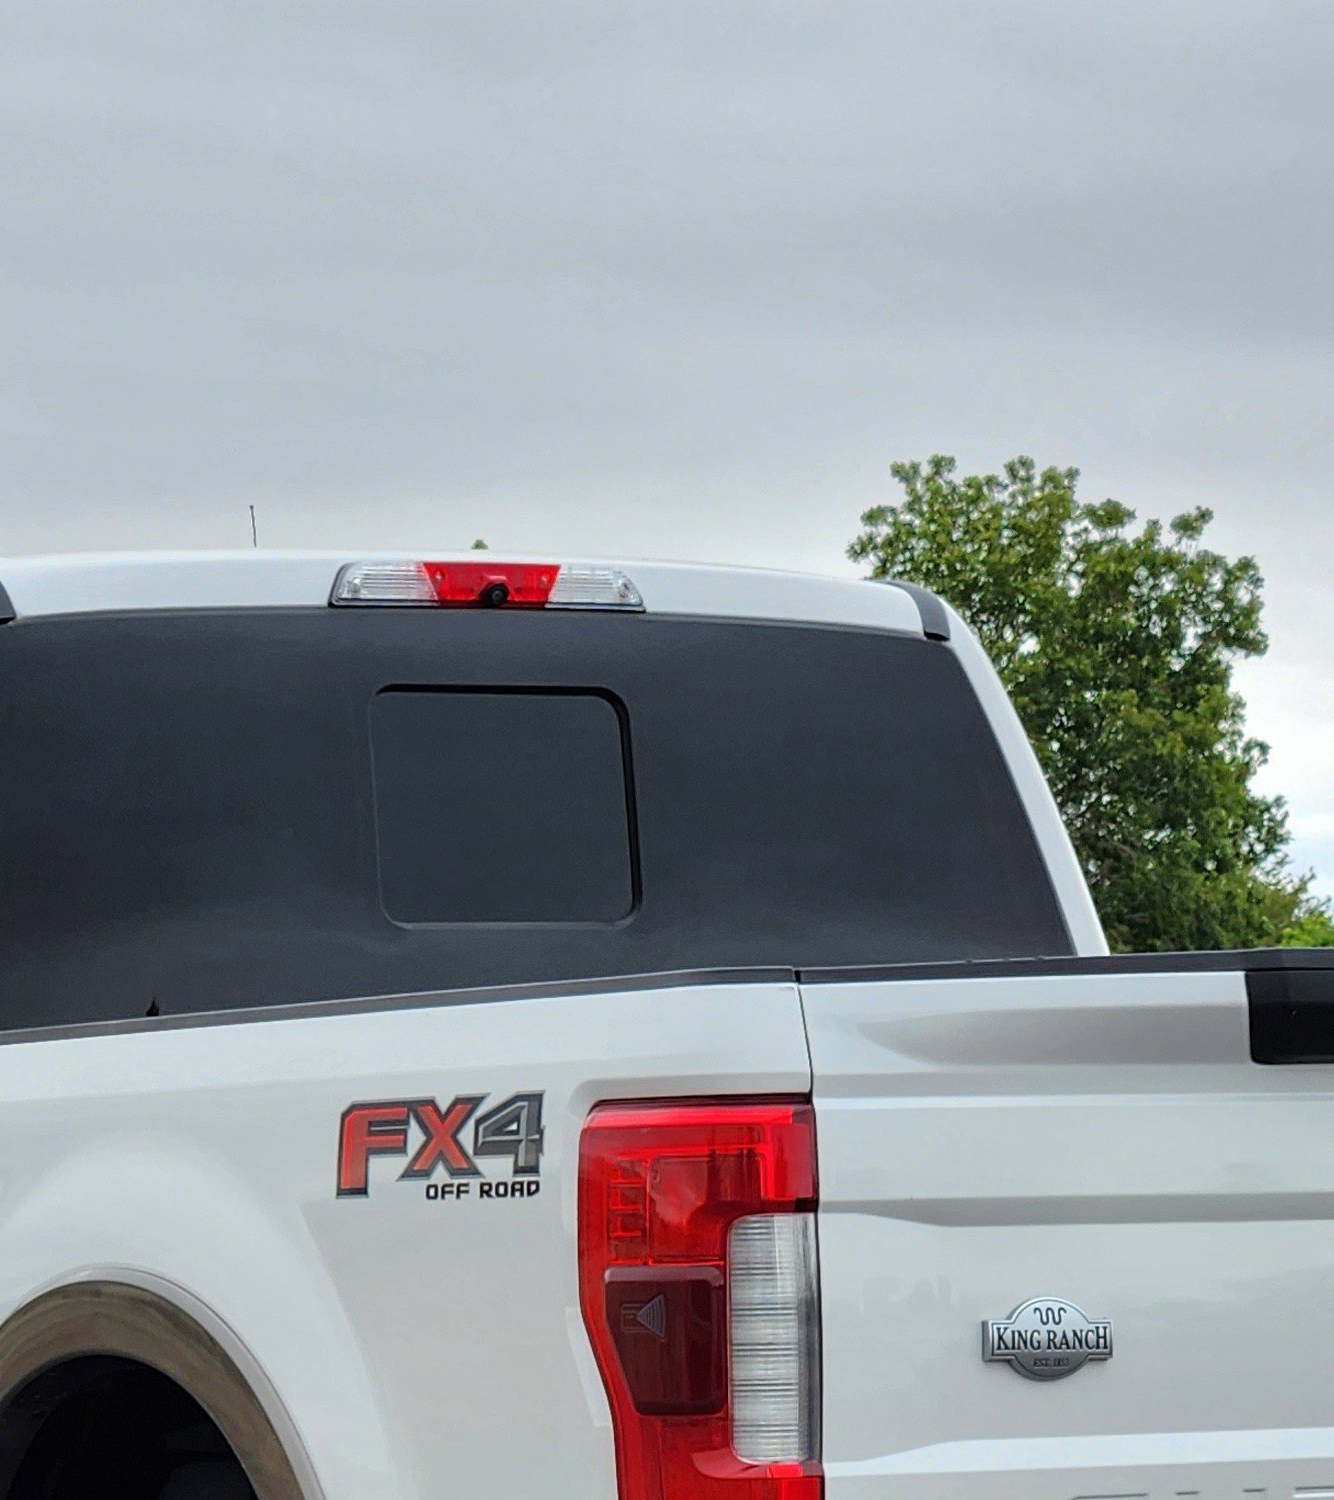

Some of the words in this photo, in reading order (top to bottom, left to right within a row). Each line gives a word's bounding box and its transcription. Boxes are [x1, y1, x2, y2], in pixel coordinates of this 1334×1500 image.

[336, 1090, 546, 1199] FX4
[425, 1183, 469, 1200] OFF
[479, 1181, 541, 1199] ROAD
[995, 1326, 1041, 1351] KING
[1047, 1325, 1109, 1351] RANCH
